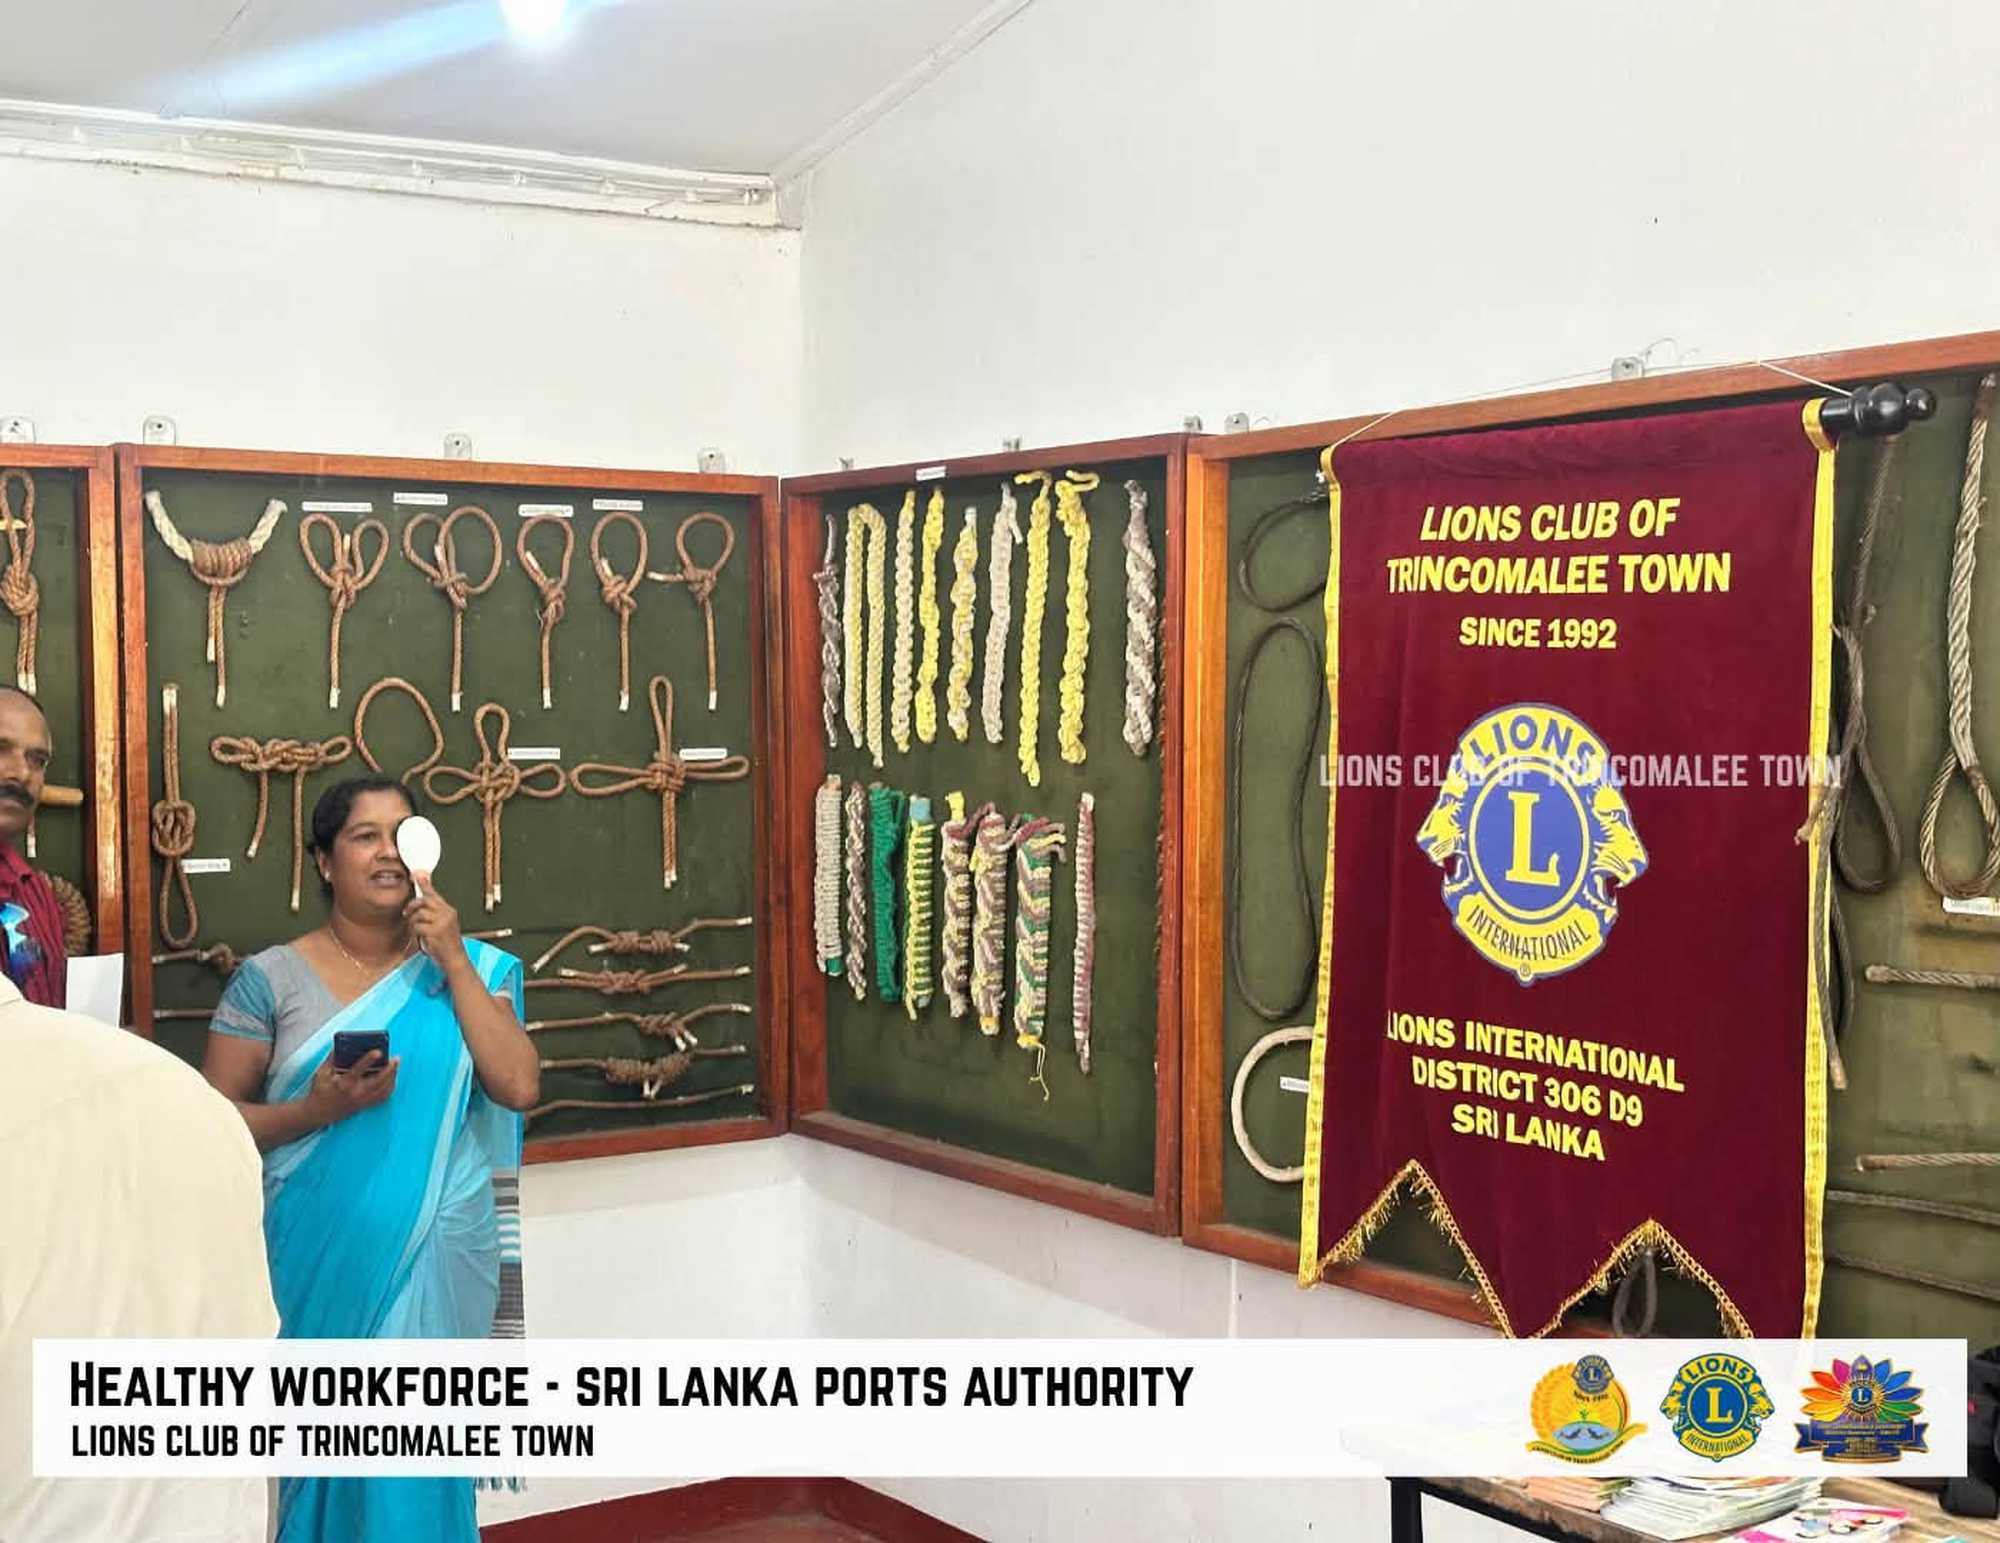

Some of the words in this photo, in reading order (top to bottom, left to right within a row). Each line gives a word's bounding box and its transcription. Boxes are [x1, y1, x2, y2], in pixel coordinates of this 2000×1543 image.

[1420, 506, 1521, 542] LIONS
[1530, 501, 1620, 541] CLUB
[1628, 498, 1681, 538] OF
[1387, 555, 1609, 594] TRINCOMALEE
[1618, 552, 1731, 593] TOWN
[1459, 617, 1541, 648] SINCE
[1547, 618, 1617, 649] 1992
[1469, 714, 1596, 767] LIONS
[1505, 791, 1561, 887] L
[1466, 904, 1593, 961] INTERNATIONAL
[1386, 1008, 1456, 1049] LIONS
[1465, 1020, 1685, 1093] INTERNATIONAL
[1412, 1055, 1538, 1104] DISTRICT
[1543, 1077, 1602, 1117] 306
[1608, 1089, 1644, 1127] D9
[1451, 1103, 1499, 1140] SRI
[1505, 1113, 1607, 1162] LANKA
